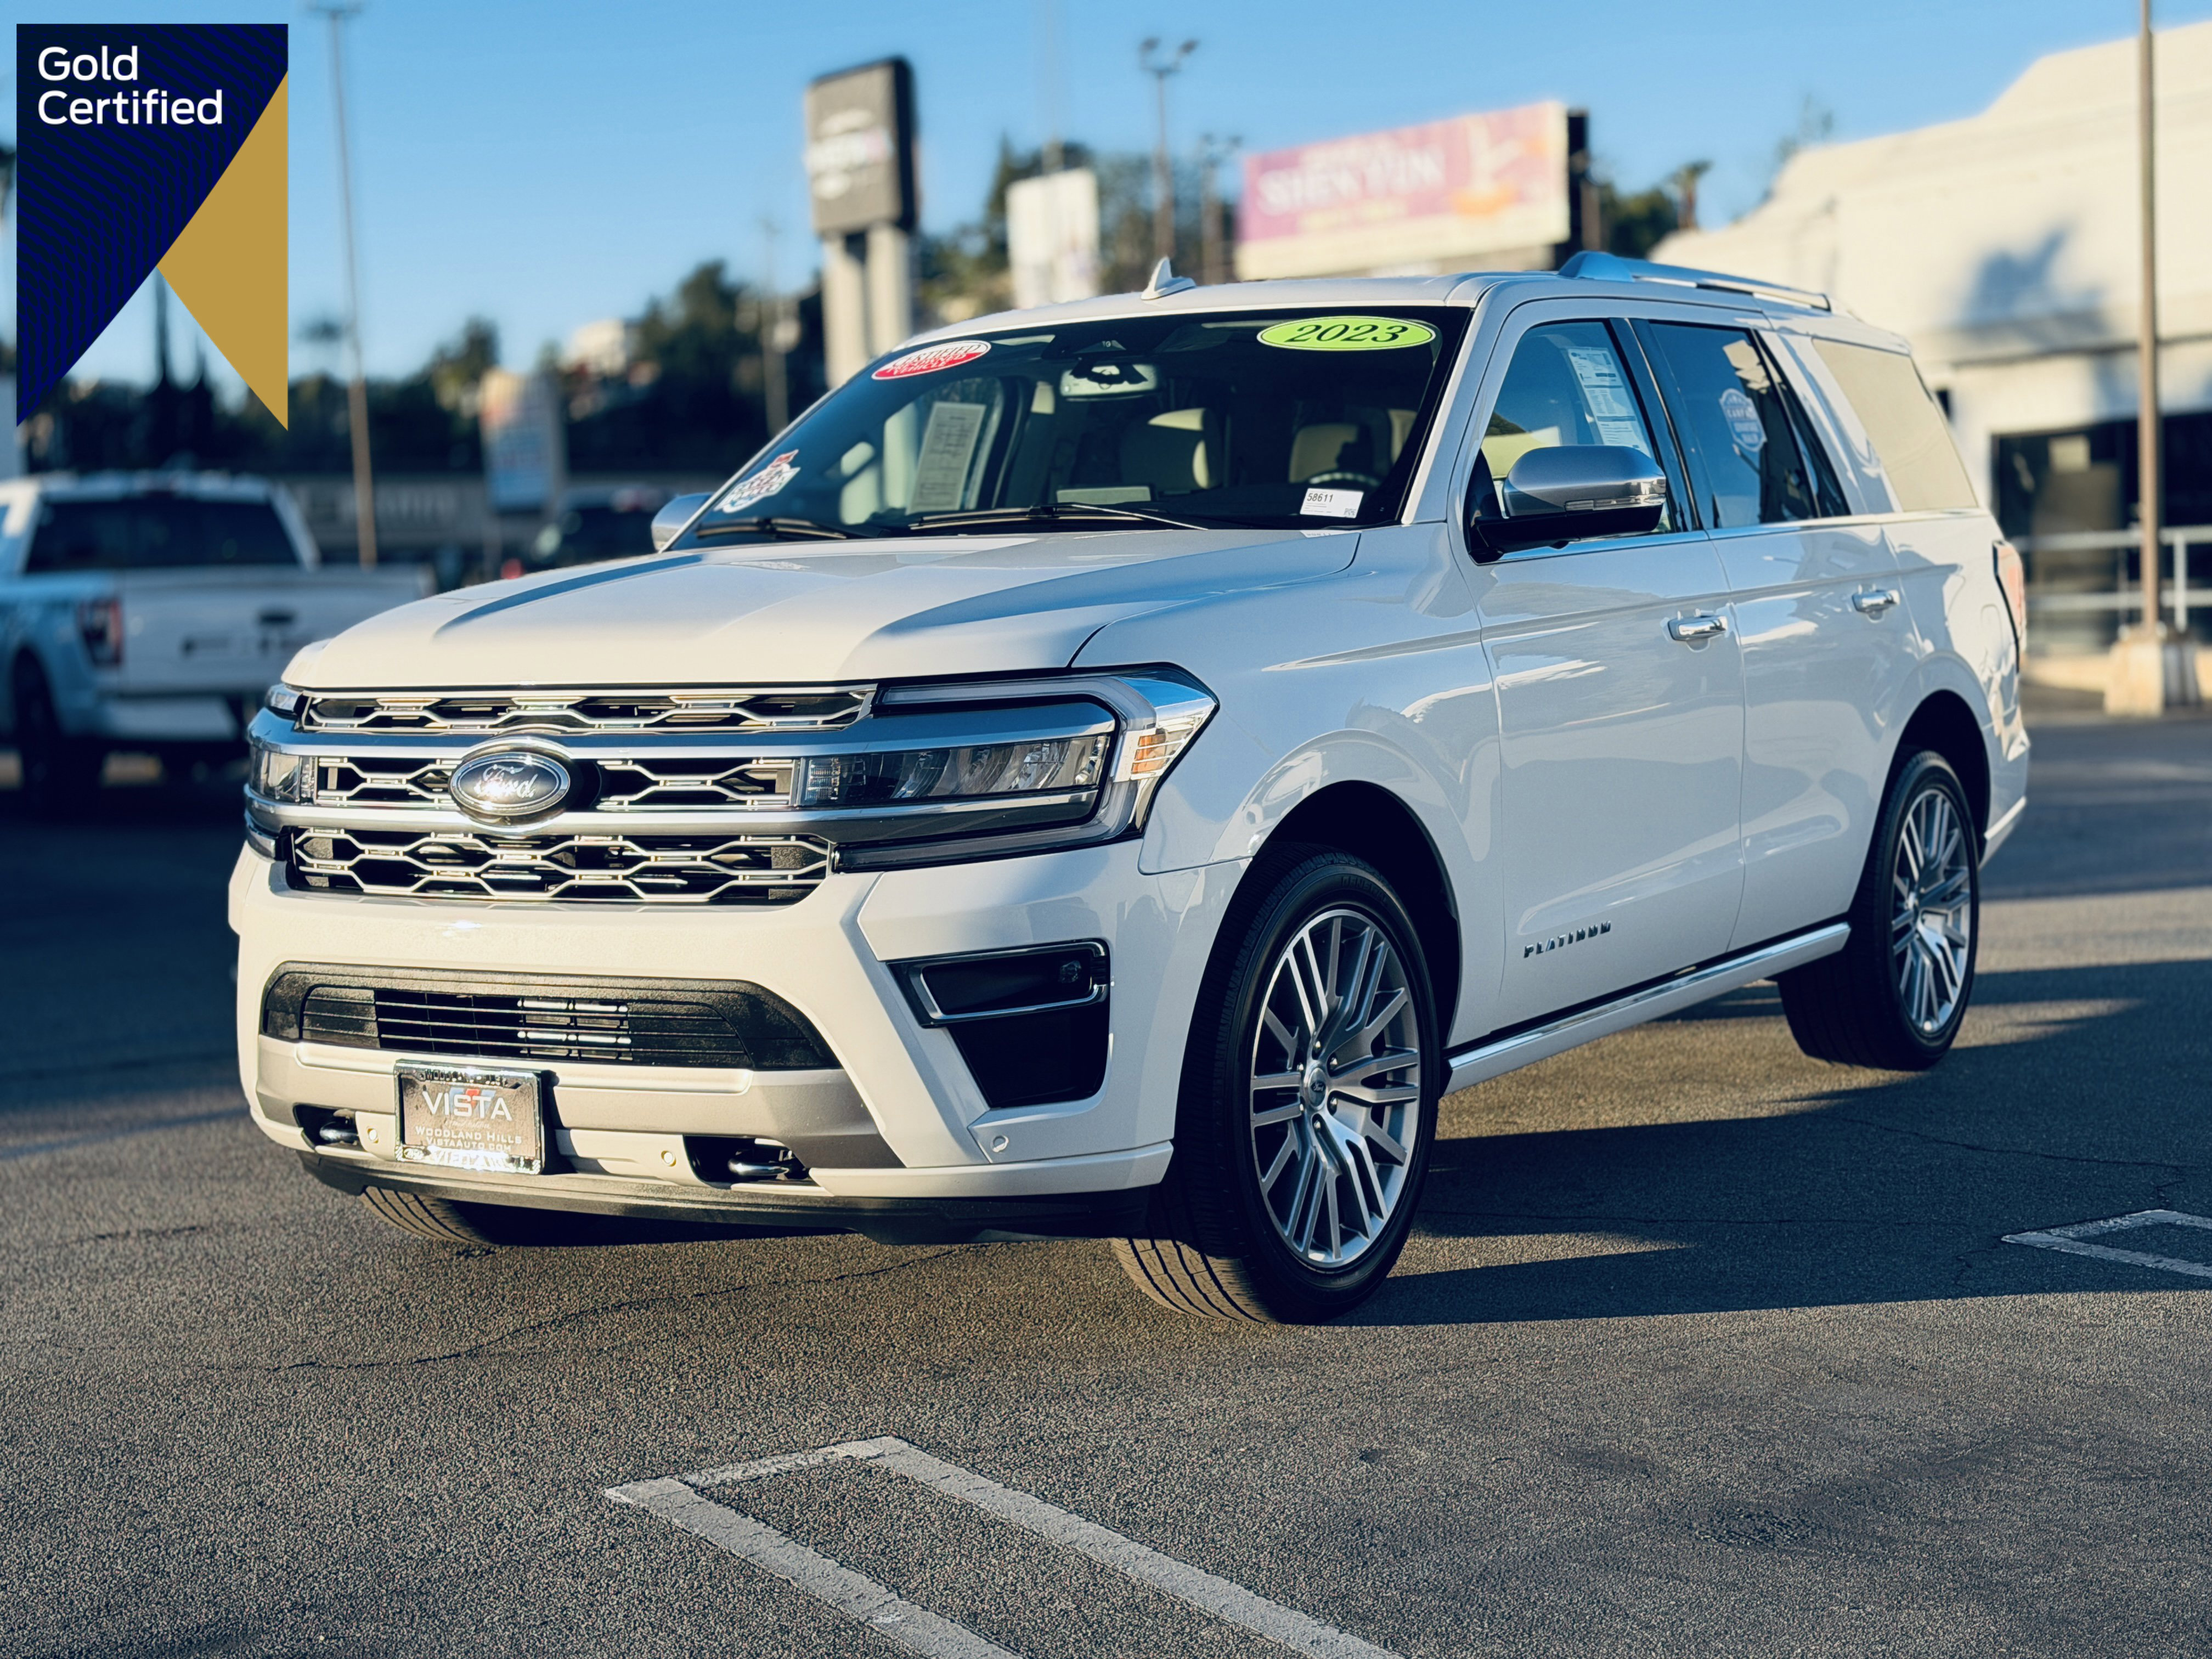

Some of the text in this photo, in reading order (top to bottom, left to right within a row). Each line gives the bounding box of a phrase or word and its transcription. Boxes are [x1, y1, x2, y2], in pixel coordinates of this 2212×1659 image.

[1284, 324, 1408, 342] 2023
[892, 344, 981, 367] CERTIFIED
[1307, 493, 1334, 503] 58611
[1523, 921, 1611, 958] PLATINUM
[422, 1090, 512, 1121] VISTA
[415, 1125, 522, 1144] WOODLAND HILLS
